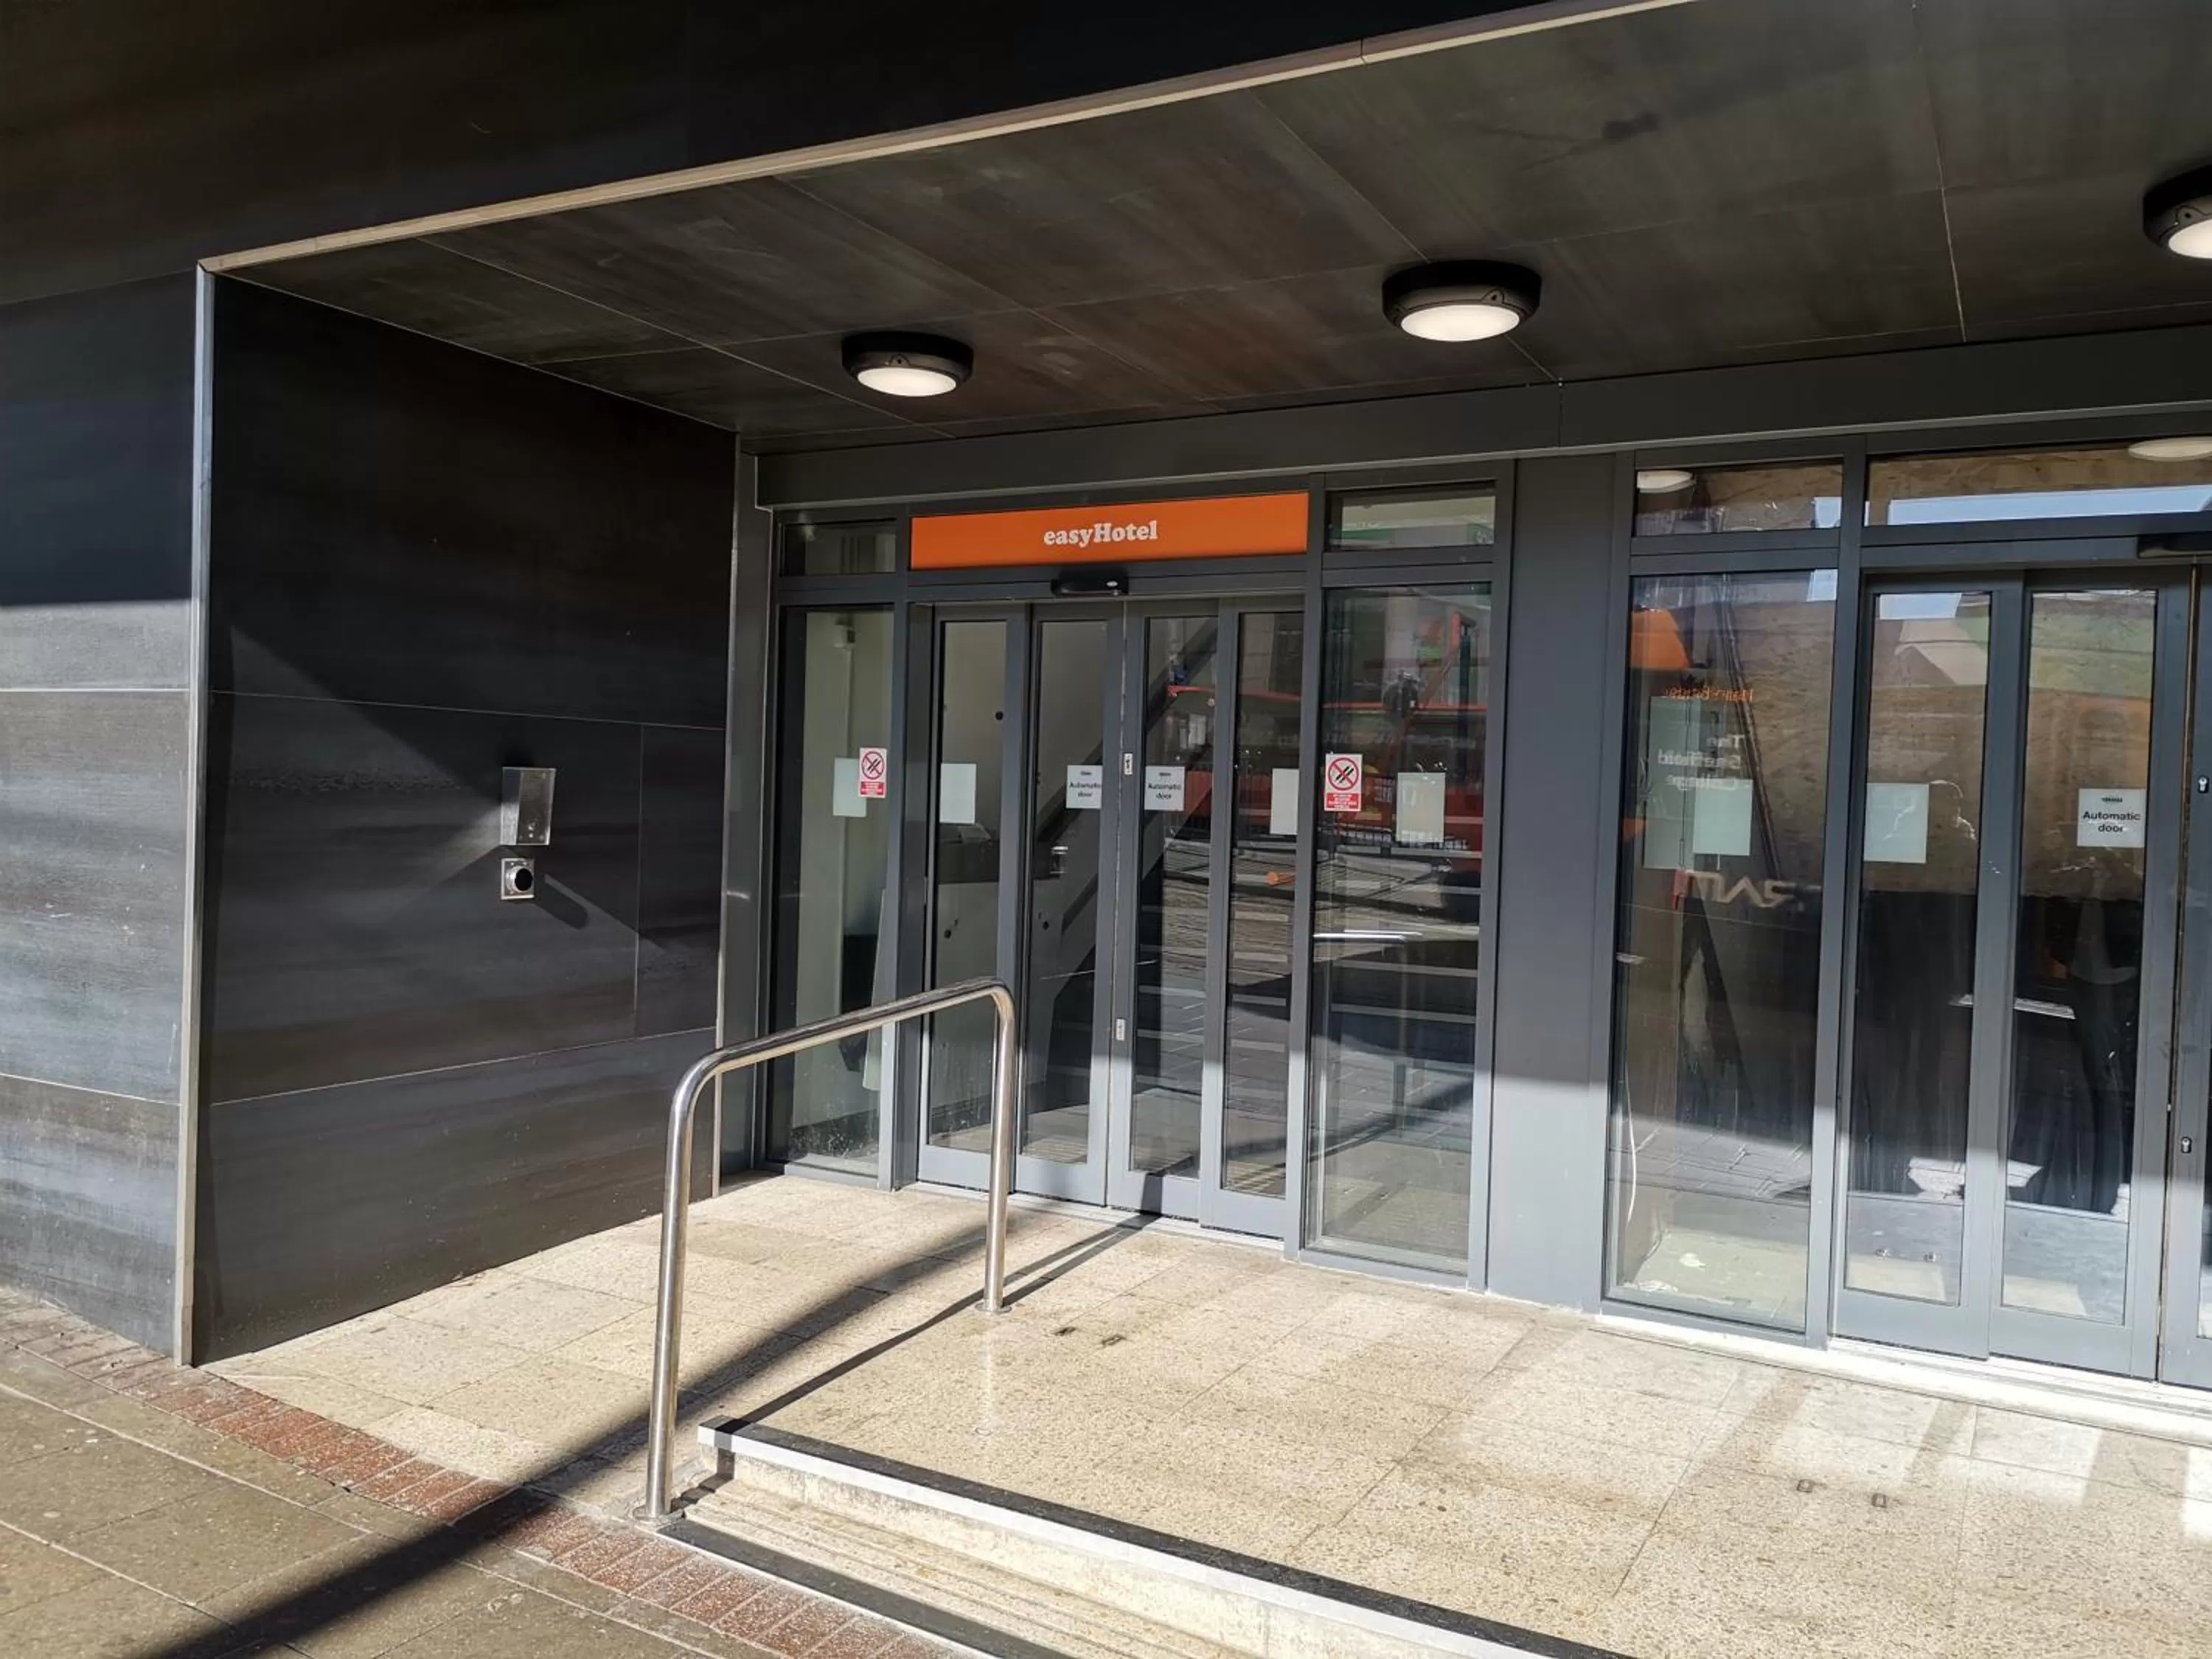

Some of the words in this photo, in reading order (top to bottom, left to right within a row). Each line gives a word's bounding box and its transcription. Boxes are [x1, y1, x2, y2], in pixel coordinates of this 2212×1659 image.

[1043, 520, 1158, 549] easyHotel
[2082, 811, 2141, 821] Automatic
[2098, 824, 2124, 832] door
